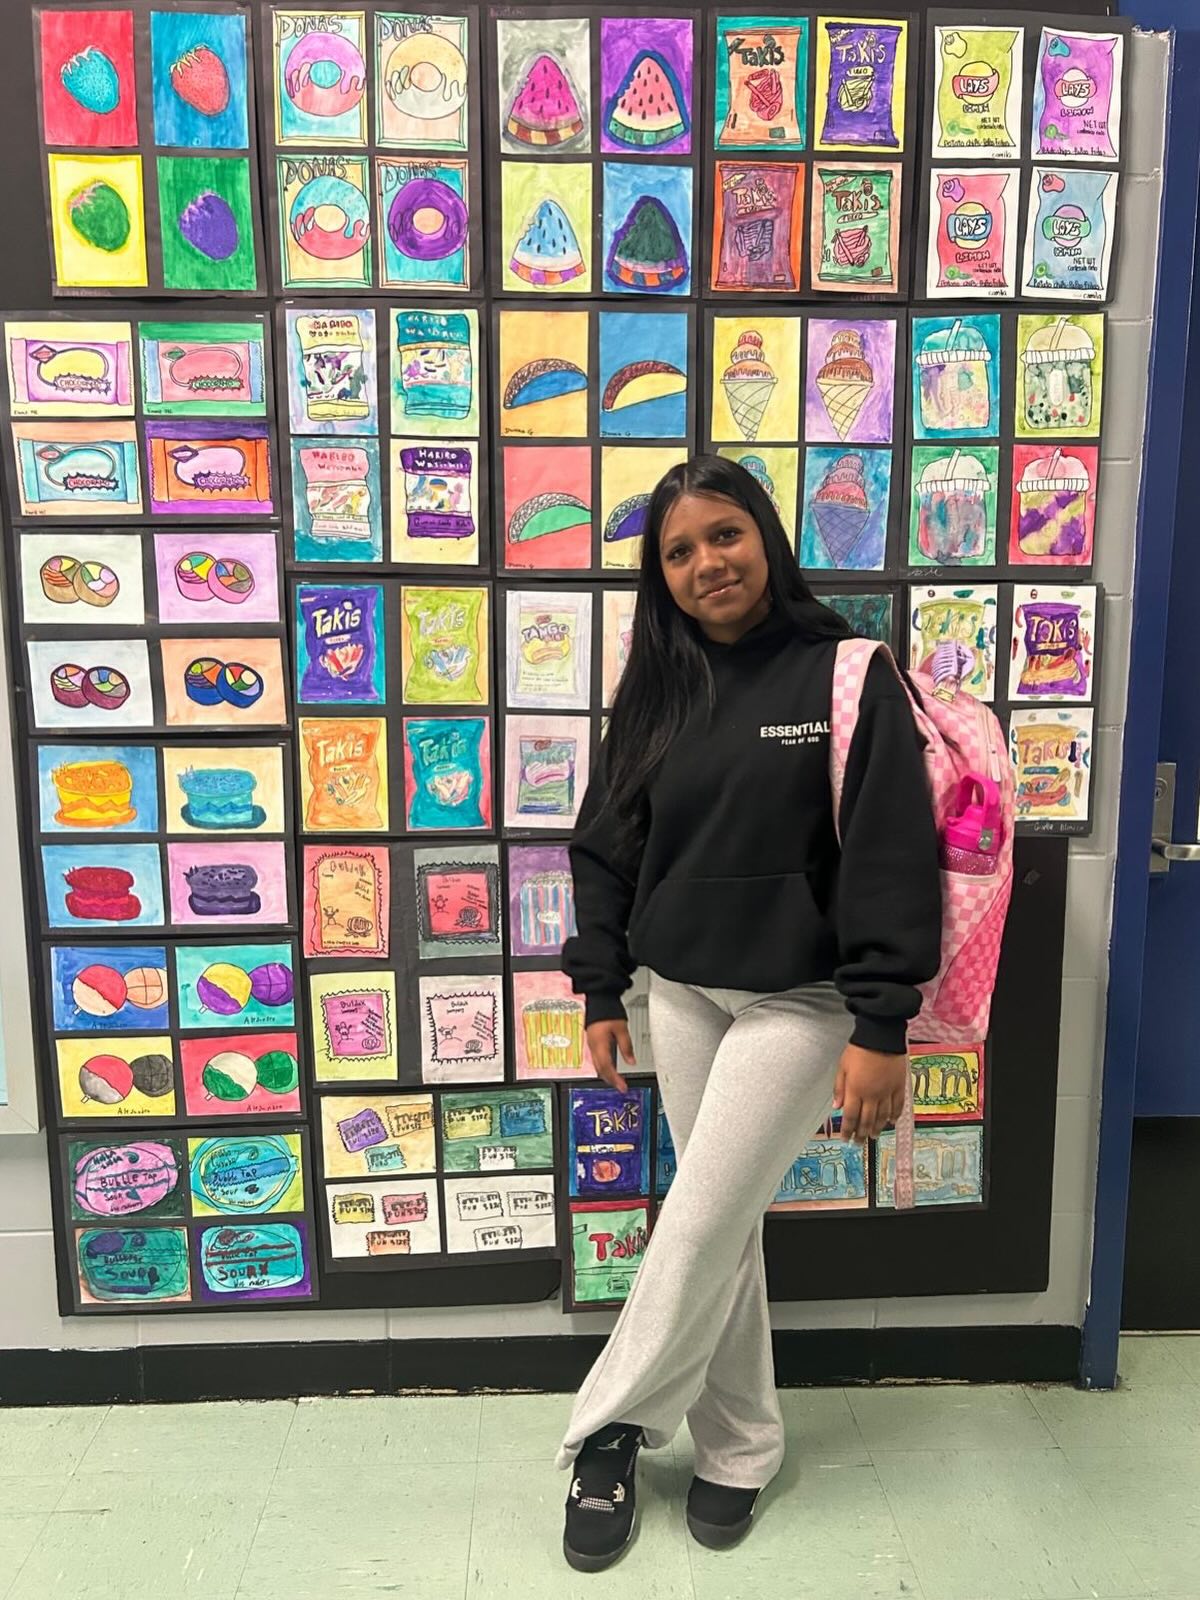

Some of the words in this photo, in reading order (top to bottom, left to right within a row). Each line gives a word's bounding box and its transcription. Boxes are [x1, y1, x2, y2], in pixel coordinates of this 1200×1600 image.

[959, 78, 990, 93] LAYS
[1061, 83, 1090, 97] LAYS
[955, 217, 987, 236] LAYS
[760, 721, 831, 738] ESSENTIAL
